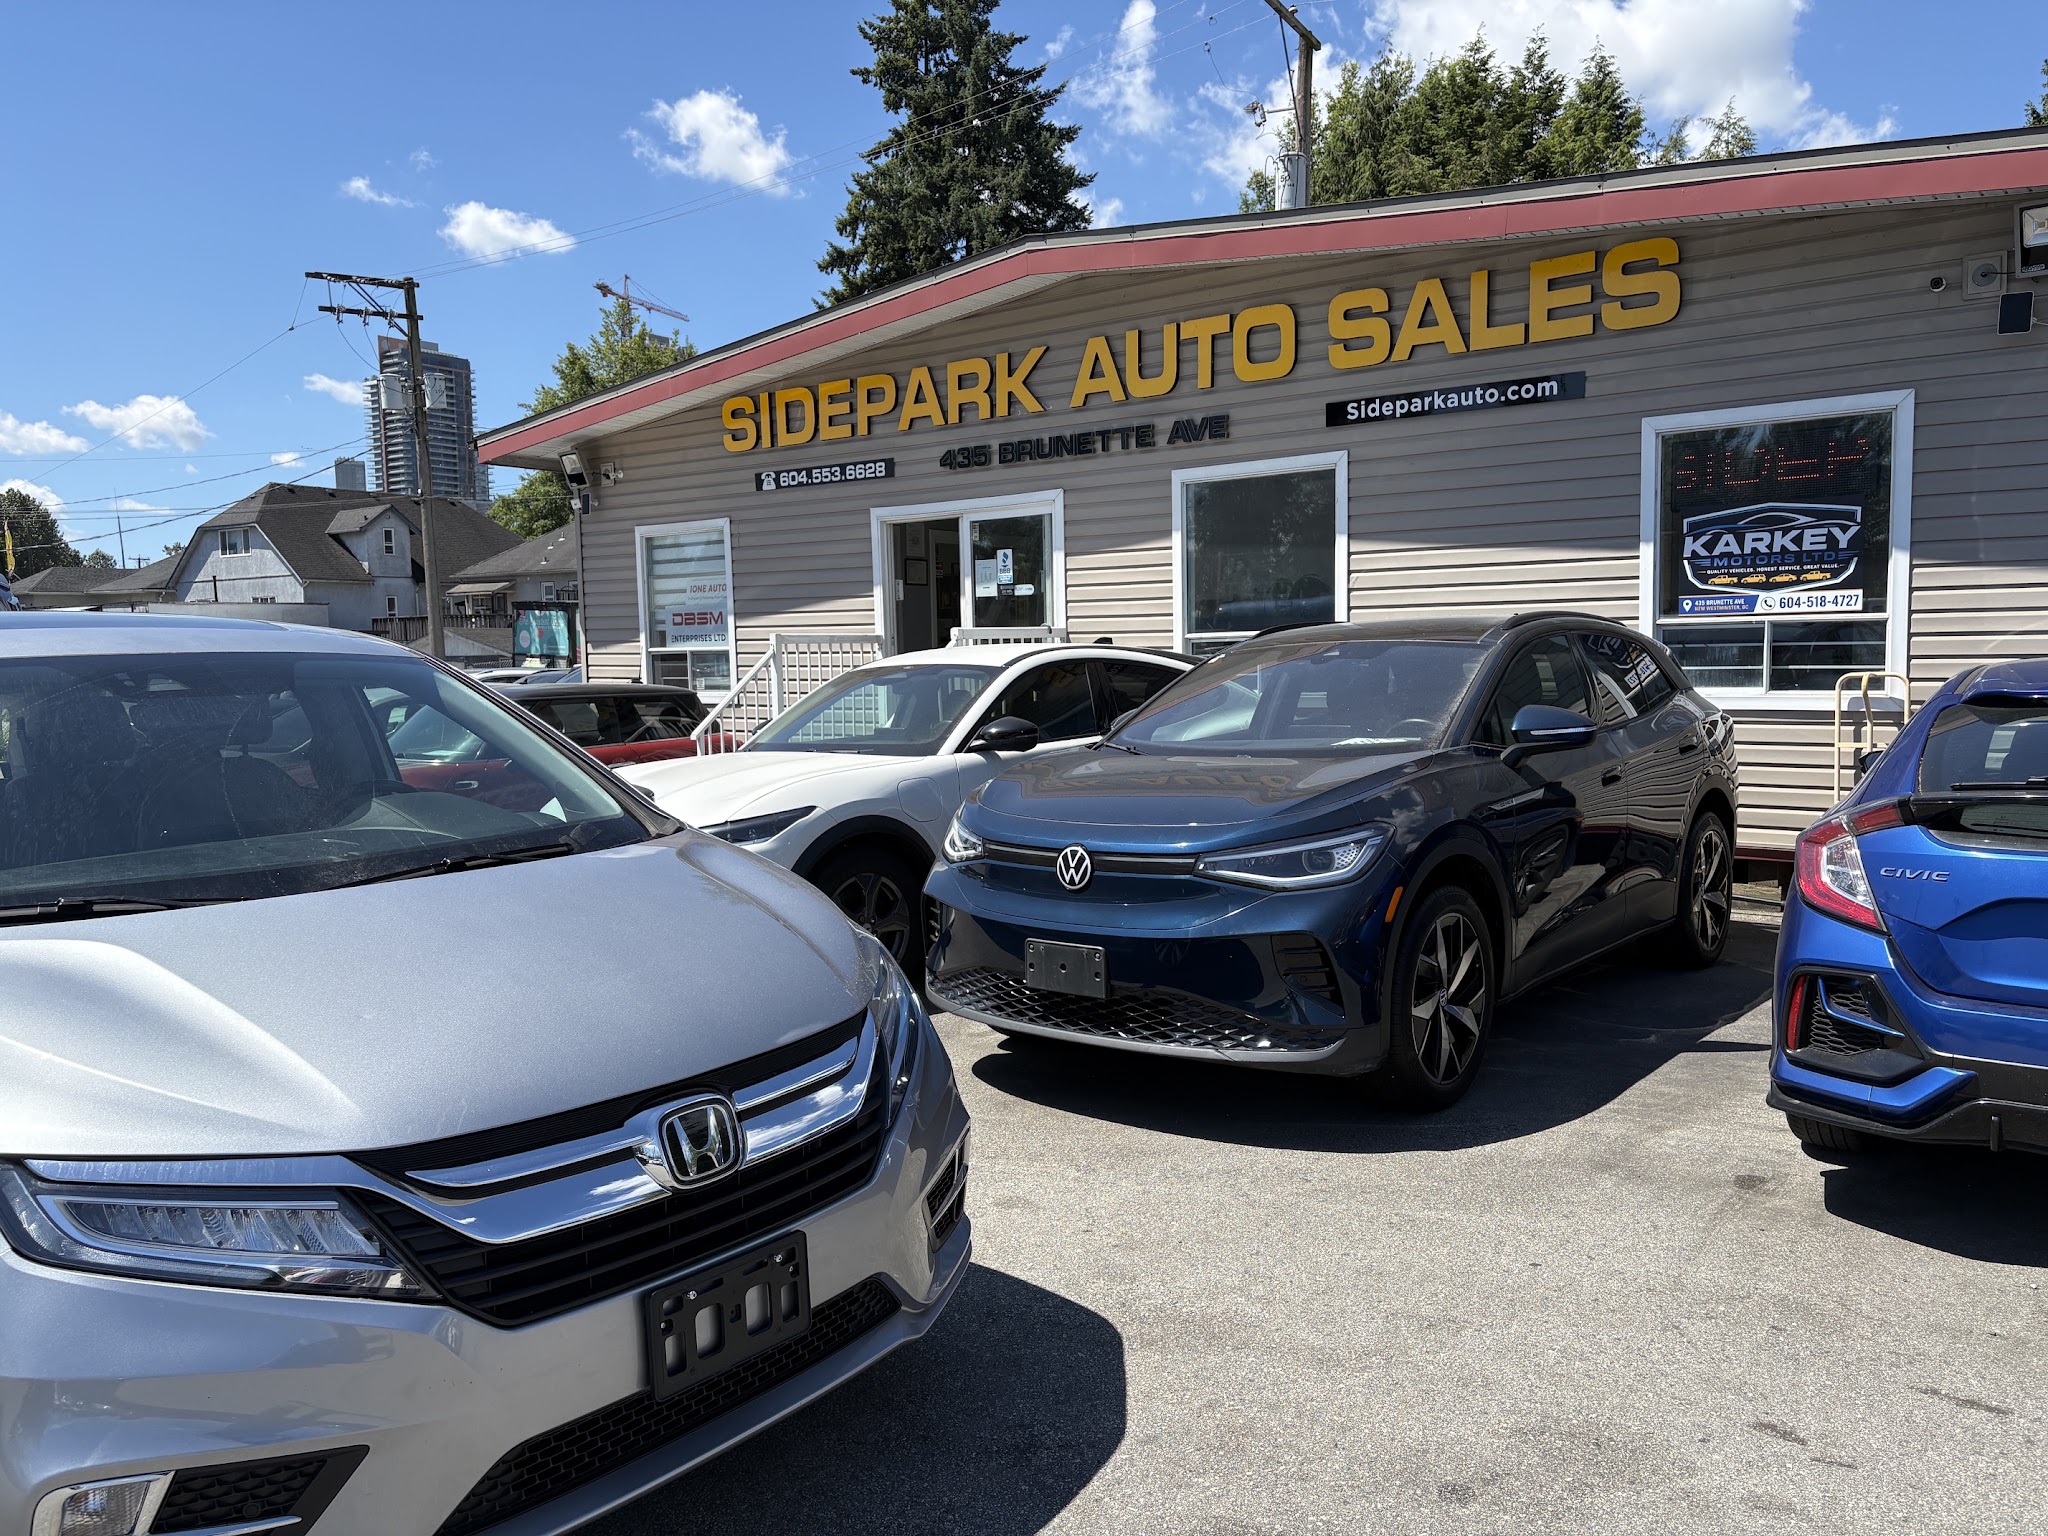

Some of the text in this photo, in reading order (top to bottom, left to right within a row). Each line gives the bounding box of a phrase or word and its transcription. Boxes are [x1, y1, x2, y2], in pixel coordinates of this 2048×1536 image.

[721, 237, 1682, 453] SIDEPARK AUTO SALES
[1346, 377, 1559, 421] Sideparkauto.com
[940, 415, 1230, 470] 435 BRUNETTE AVE
[780, 462, 886, 487] 604.553.6628
[1682, 525, 1862, 558] KARKEY
[1713, 551, 1836, 567] MOTORS LTD
[708, 583, 727, 593] AUTO
[1779, 594, 1860, 609] 604-518-4727
[672, 610, 724, 627] DBSM
[671, 633, 727, 643] ENTERPRISES LTD
[1879, 867, 1950, 882] CIVIC
